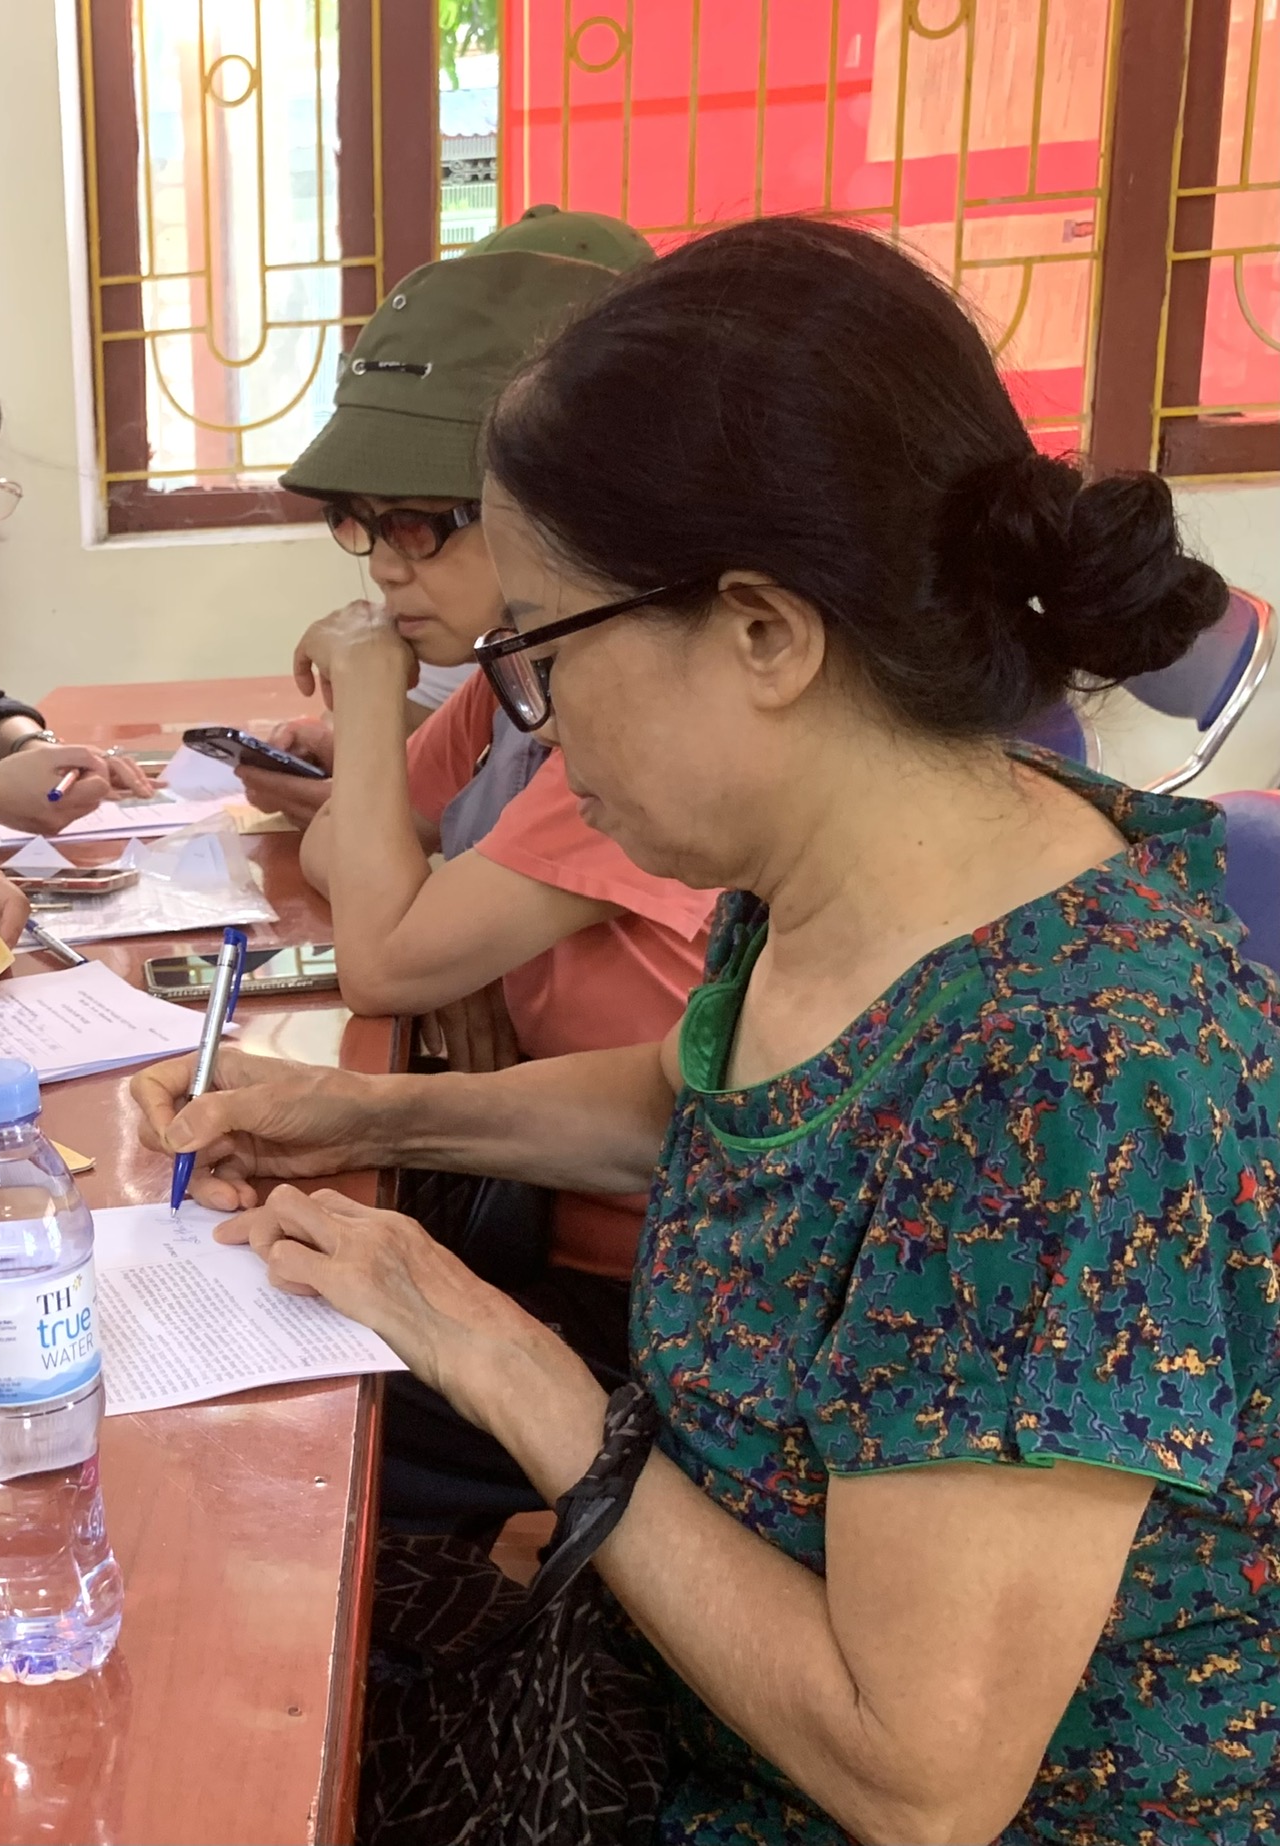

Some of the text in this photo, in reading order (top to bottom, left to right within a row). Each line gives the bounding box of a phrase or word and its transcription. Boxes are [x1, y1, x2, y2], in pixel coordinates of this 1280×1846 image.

[36, 1286, 72, 1316] TH
[36, 1307, 91, 1349] true
[41, 1332, 94, 1371] WATER
